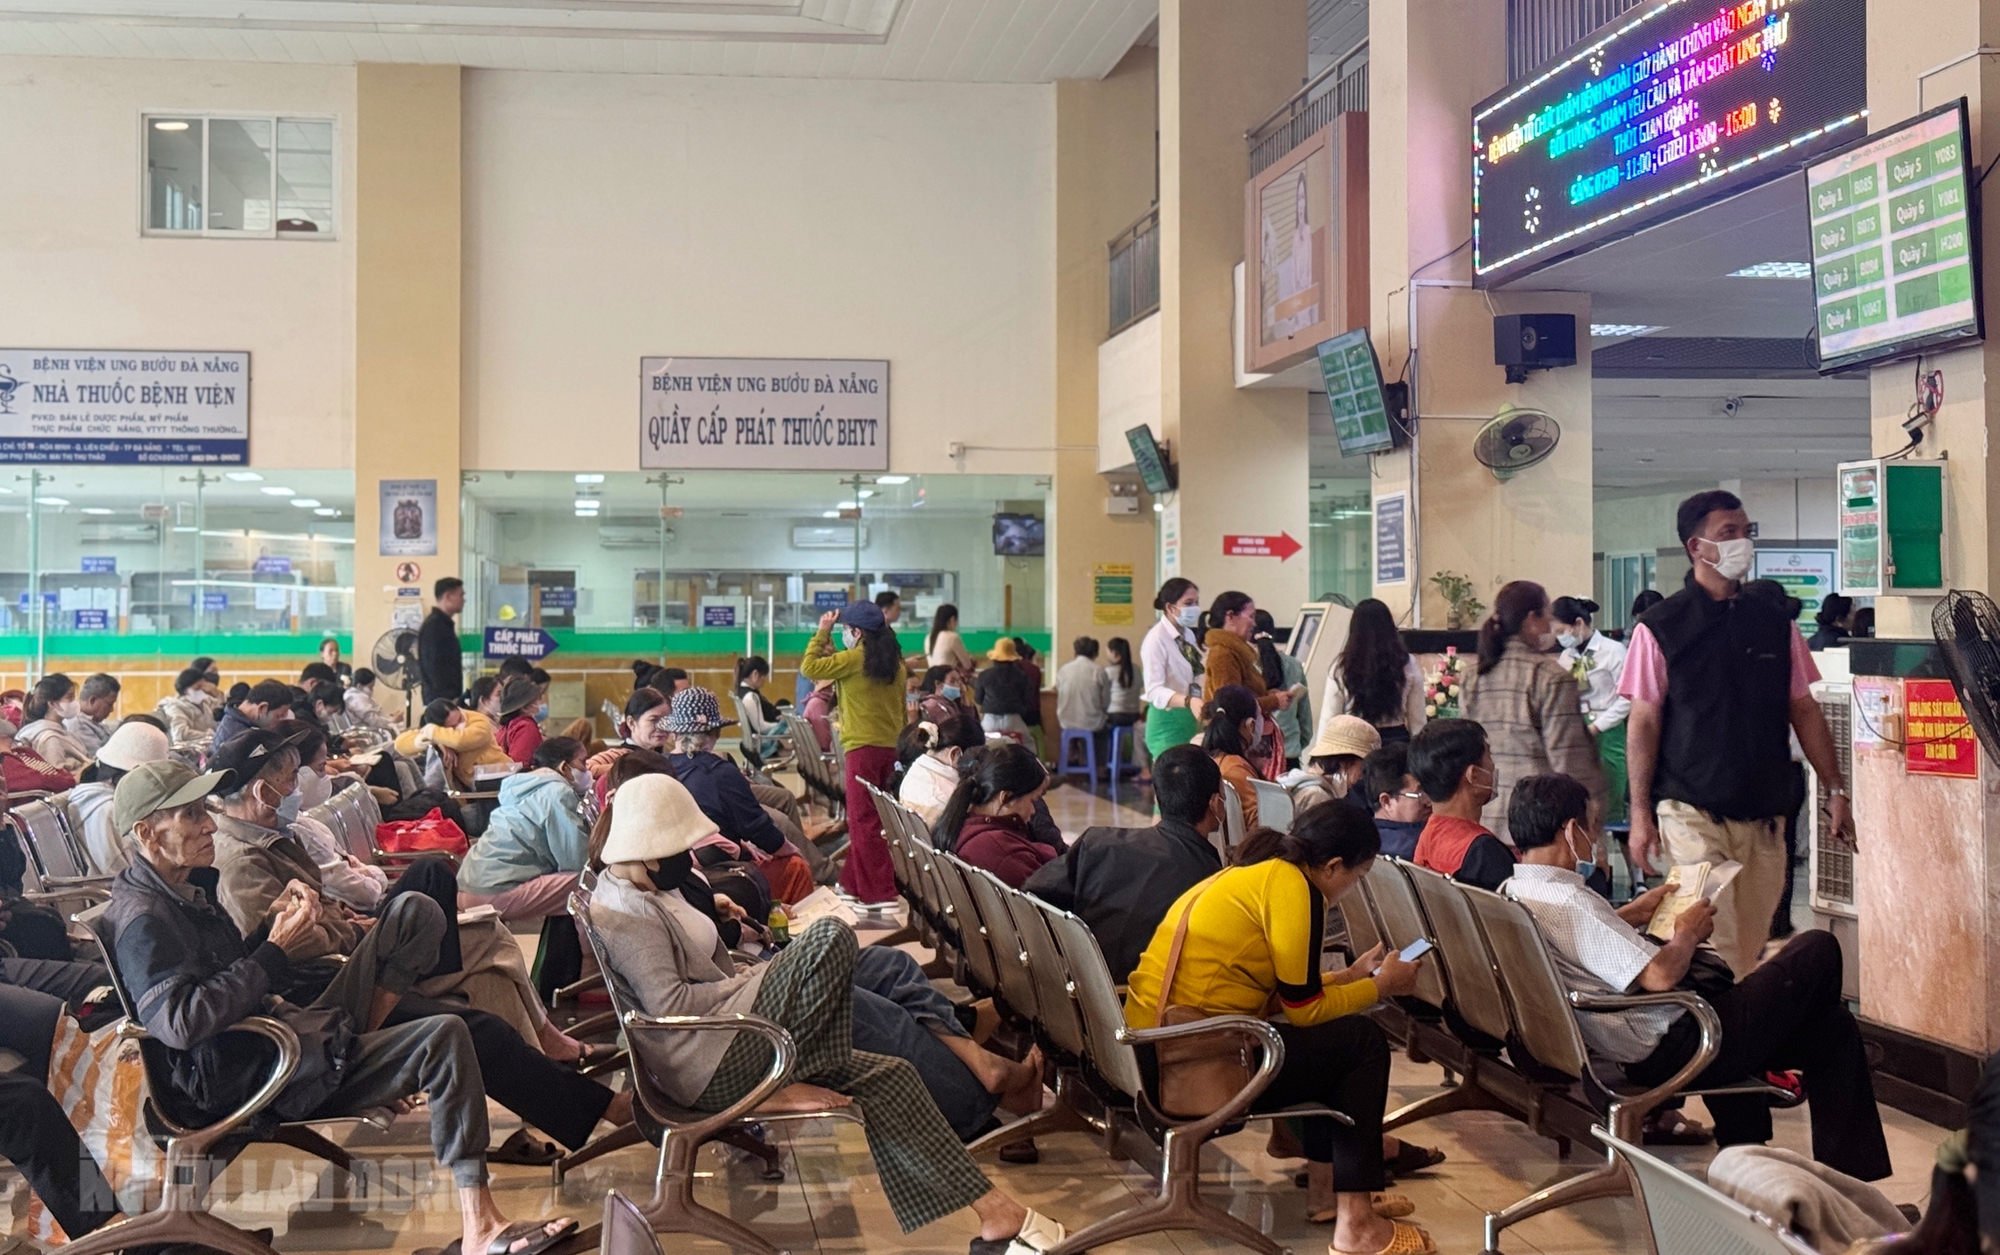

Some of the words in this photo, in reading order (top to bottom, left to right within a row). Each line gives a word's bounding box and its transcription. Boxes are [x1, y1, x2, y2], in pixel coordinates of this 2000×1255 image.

[1633, 51, 1650, 84] GIỜ
[1652, 42, 1679, 74] HÀNH
[1680, 22, 1712, 59] CHÍNH
[1713, 8, 1734, 41] VÀO
[1600, 100, 1627, 133] KHÁM
[1627, 88, 1645, 119] YÊU
[1646, 78, 1667, 110] CẦU
[1667, 67, 1682, 99] VÀ
[1706, 42, 1736, 80] SOÁT
[1737, 32, 1762, 64] UNG
[1613, 122, 1637, 155] THỜI
[1639, 114, 1664, 143] GIAN
[1569, 174, 1595, 205] SÁNG
[1726, 102, 1757, 136] 16:00
[1894, 161, 1915, 183] Quầy
[1915, 157, 1922, 173] 5
[1934, 144, 1957, 165] Y083
[1818, 190, 1837, 211] Quầy
[1836, 187, 1843, 202] 1
[1897, 203, 1918, 225] Quầy
[1918, 199, 1925, 214] 6
[1820, 230, 1840, 250] Quầy
[1840, 227, 1846, 242] 2
[1899, 245, 1921, 267] Quầy
[1921, 242, 1928, 257] 7
[1940, 232, 1963, 252] H200
[1823, 269, 1843, 290] Quầy
[1842, 267, 1849, 282] 3
[1826, 309, 1845, 330] Quầy
[1845, 307, 1852, 322] 4
[33, 356, 70, 373] BỆNH
[74, 356, 106, 374] VIỆN
[111, 359, 138, 372] UNG
[141, 356, 176, 373] BƯỚU
[180, 357, 199, 373] ĐÀ
[203, 356, 240, 373] NẴNG
[33, 379, 70, 403] NHÀ
[76, 376, 136, 404] THUỐC
[140, 381, 188, 408] BỆNH
[194, 382, 236, 408] VIỆN
[652, 372, 693, 395] BỆNH
[697, 373, 732, 395] VIỆN
[737, 376, 766, 392] UNG
[771, 372, 810, 393] BƯỚU
[813, 374, 835, 393] ĐÀ
[838, 372, 878, 394] NẴNG
[31, 425, 56, 434] THỰC
[58, 422, 83, 433] PHẨM
[87, 423, 111, 433] CHỨC
[170, 425, 200, 433] THÔNG
[93, 413, 117, 423] DƯỢC
[164, 411, 188, 421] PHẨM
[649, 403, 692, 451] QUẦY
[697, 404, 728, 445] CẤP
[735, 407, 776, 445] PHÁT
[782, 405, 833, 446] THUỐC
[837, 418, 878, 446] BHYT
[494, 628, 514, 642] CẤP
[515, 630, 540, 643] PHÁT
[488, 641, 519, 654] THUỐC
[520, 643, 544, 655] BHYT
